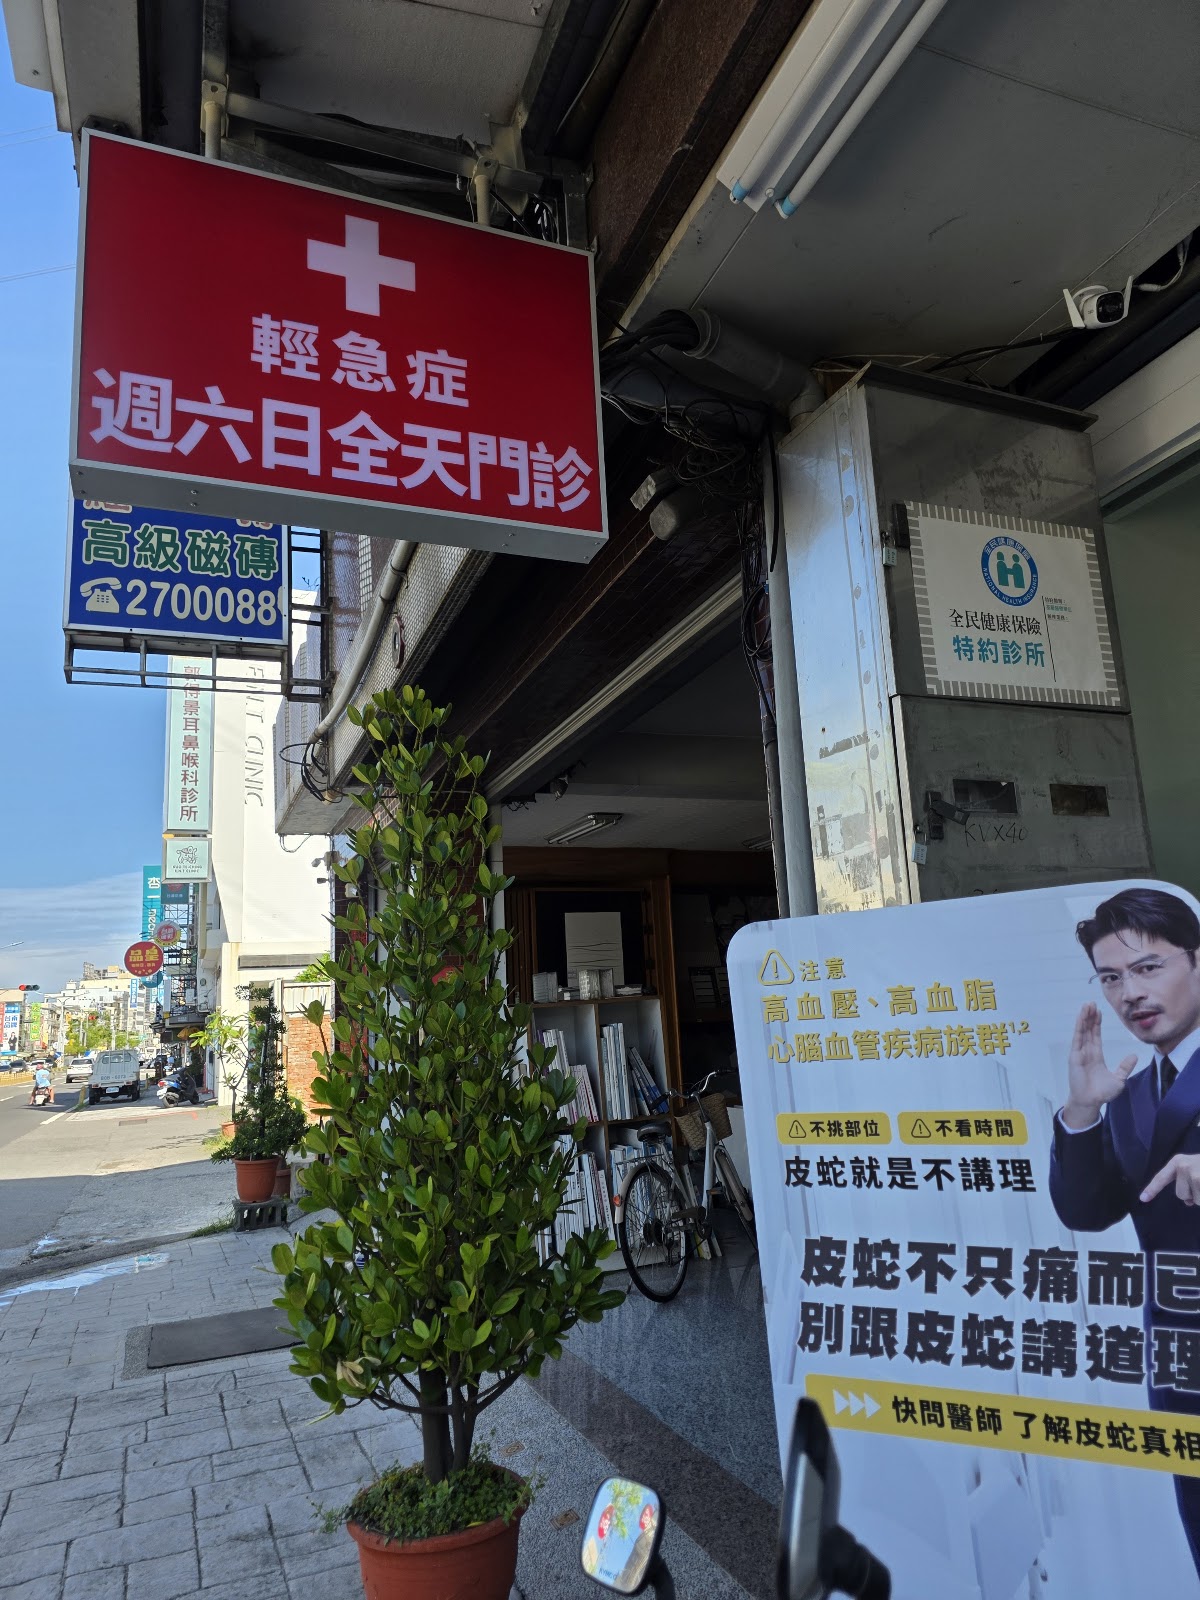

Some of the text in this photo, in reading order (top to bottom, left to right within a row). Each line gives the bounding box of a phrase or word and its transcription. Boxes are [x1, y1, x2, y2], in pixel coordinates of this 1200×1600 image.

[250, 313, 470, 408] 輕急症
[90, 367, 595, 513] 週六日全天門診
[82, 518, 279, 581] 高級磁磚
[126, 578, 283, 626] 2700088
[983, 567, 1001, 597] NATIONAL
[1001, 596, 1023, 605] HEALTH
[949, 608, 1042, 636] 全民健康保險
[952, 634, 1045, 668] 特約診所
[179, 665, 201, 823] 郭得景耳鼻喉科診所
[244, 735, 265, 808] CLINIC
[799, 957, 846, 982] 注意
[760, 978, 998, 1024] 高血壓、高血脂
[809, 1119, 881, 1138] 不挑部位
[935, 1118, 1015, 1138] 不看時間
[784, 1155, 1038, 1193] 皮蛇就是不講理
[799, 1234, 1200, 1314] 皮蛇不只痛而已
[797, 1300, 1200, 1393] 別跟皮蛇講道理
[891, 1395, 1200, 1463] 快問醫師 了解皮蛇真相
